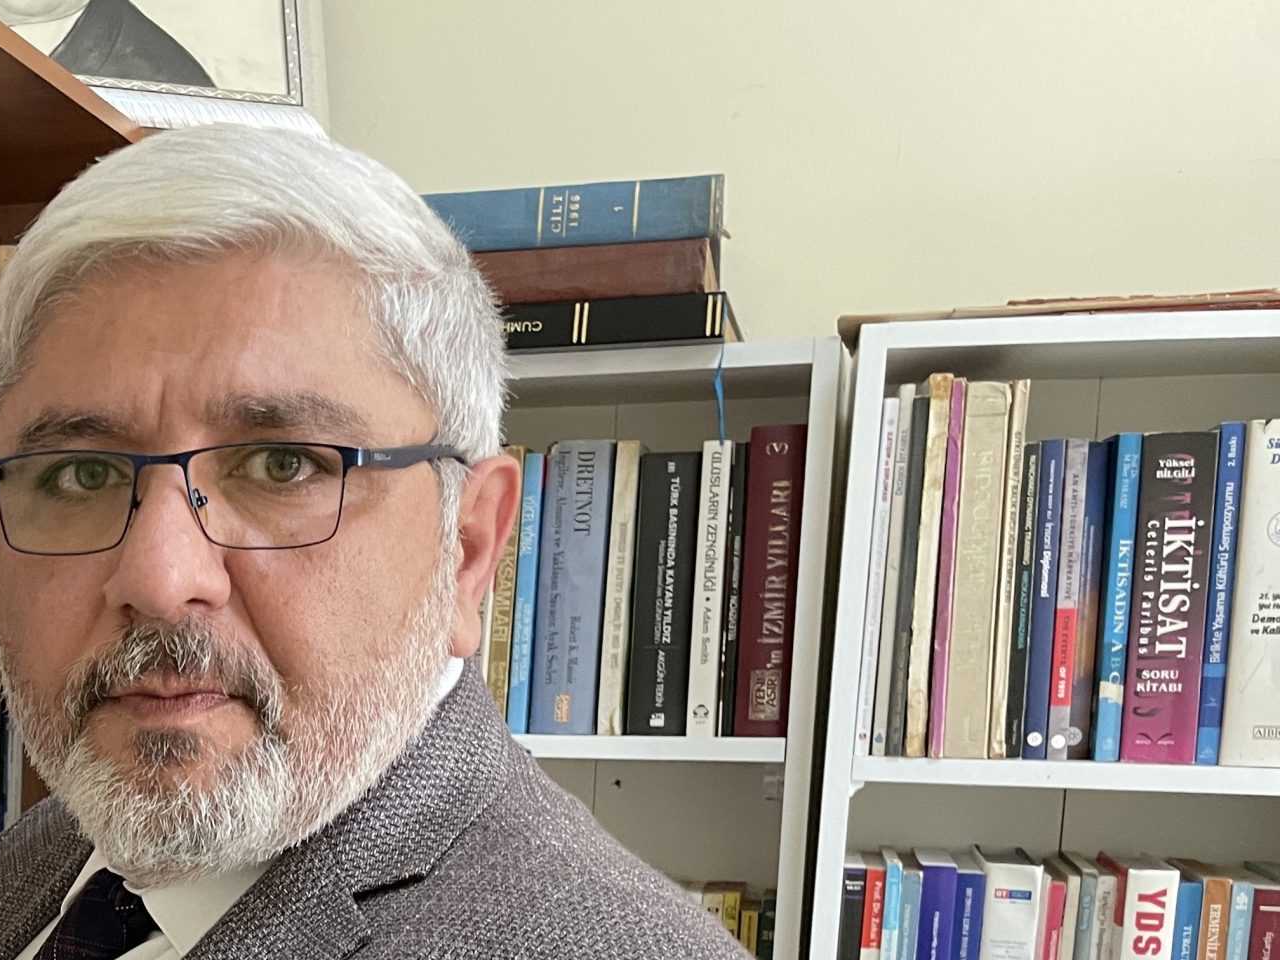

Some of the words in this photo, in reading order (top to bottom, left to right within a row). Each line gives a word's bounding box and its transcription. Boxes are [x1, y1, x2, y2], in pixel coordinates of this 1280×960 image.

[573, 450, 596, 536] DRETNOT
[669, 476, 680, 507] TÜRK
[765, 480, 792, 579] YILLARI
[1219, 482, 1236, 551] Sempozyumu
[1040, 551, 1053, 598] Diplomasi
[1144, 519, 1161, 583] Ceteris
[664, 569, 676, 607] KAYAN
[1113, 540, 1133, 634] İKTİSADIN
[1154, 516, 1205, 658] İKTİSAT
[662, 608, 674, 644] YILDIZ
[703, 606, 712, 631] Adam
[757, 581, 786, 645] İZMİR
[1137, 590, 1155, 656] Paribus
[656, 649, 666, 682] AKGÜN
[700, 635, 711, 665] Smith
[655, 683, 664, 708] TEKİN
[1136, 681, 1183, 694] KİTABI
[1141, 669, 1180, 681] SORU
[1132, 887, 1168, 957] YDS
